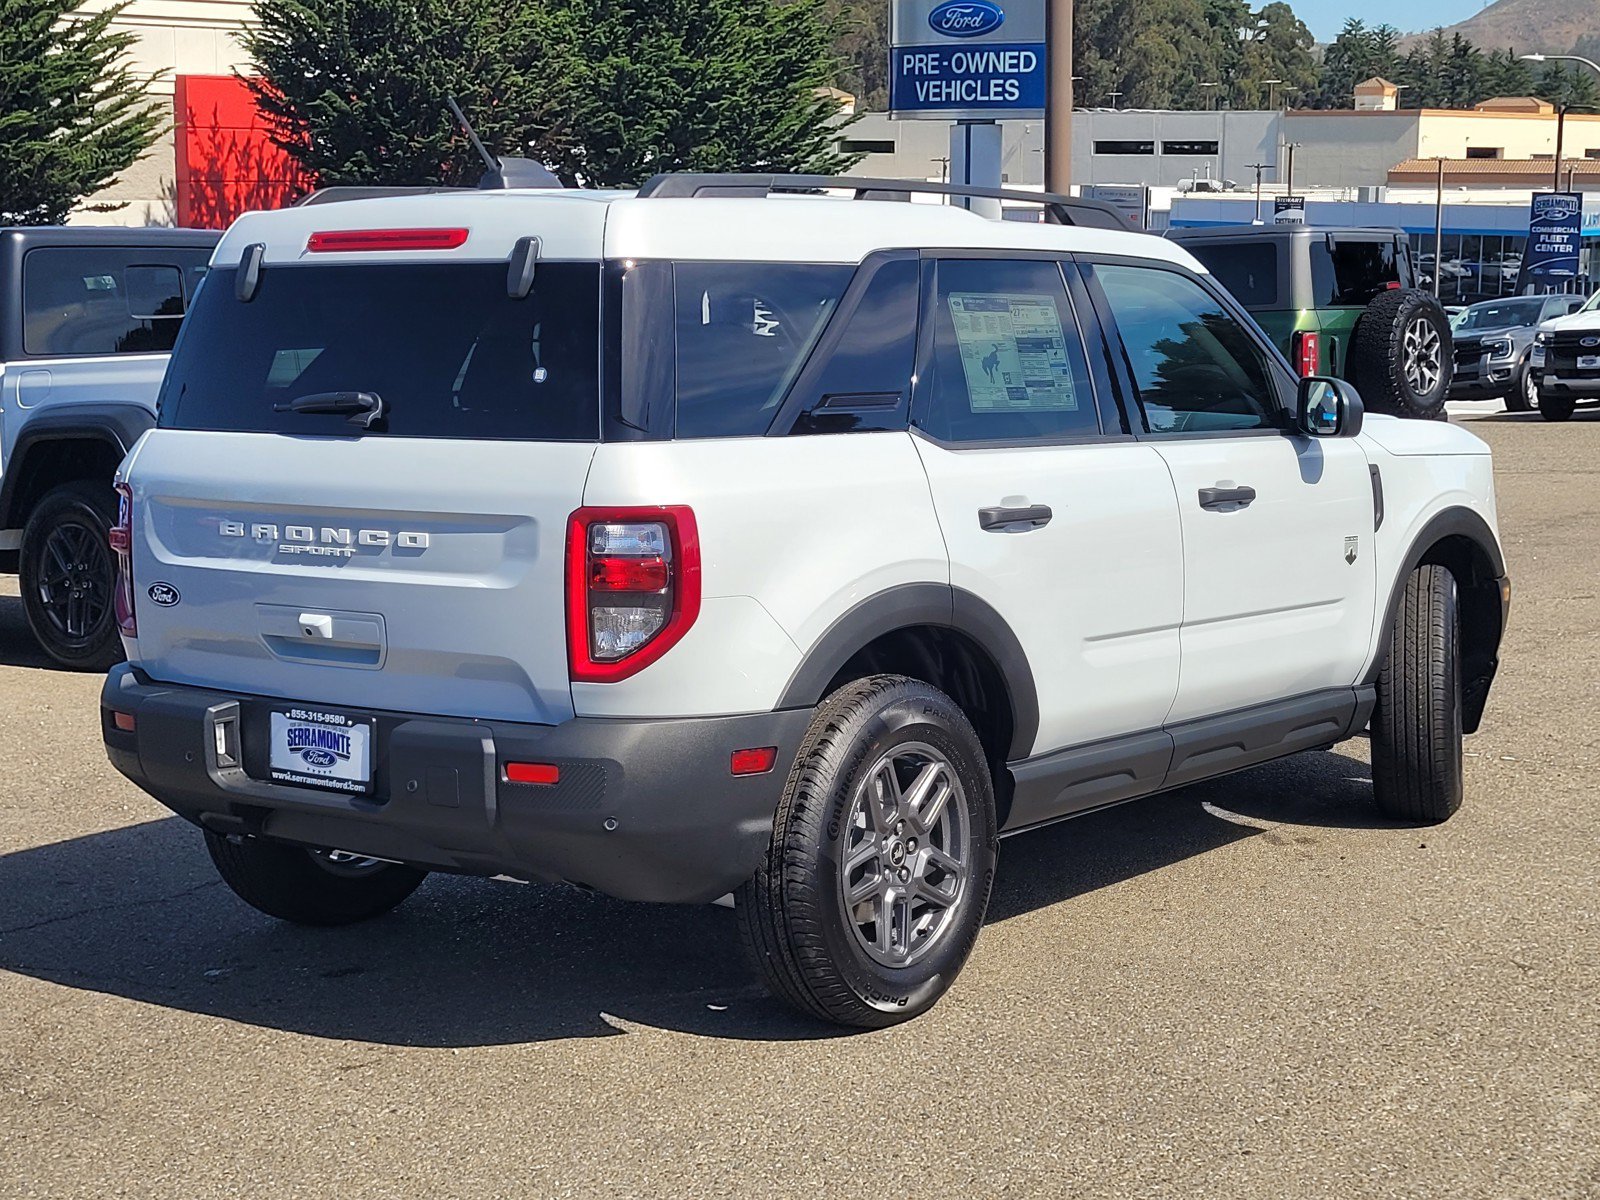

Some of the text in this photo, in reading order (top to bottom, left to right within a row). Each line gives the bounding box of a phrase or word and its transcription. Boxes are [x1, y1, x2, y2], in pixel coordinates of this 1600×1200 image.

[942, 7, 985, 29] Ford
[916, 79, 1020, 102] VEHICLES
[1531, 226, 1579, 234] COMMERCIAL
[1540, 234, 1569, 243] FLEET
[1534, 244, 1573, 253] CENTER
[219, 522, 429, 548] BRONCO
[278, 544, 357, 558] SPORT
[151, 585, 175, 603] Ford
[291, 709, 345, 725] 855-315-9580
[287, 727, 351, 755] SERRAMONTE
[307, 750, 331, 765] Ford
[271, 772, 366, 792] www.serramonteford.com
